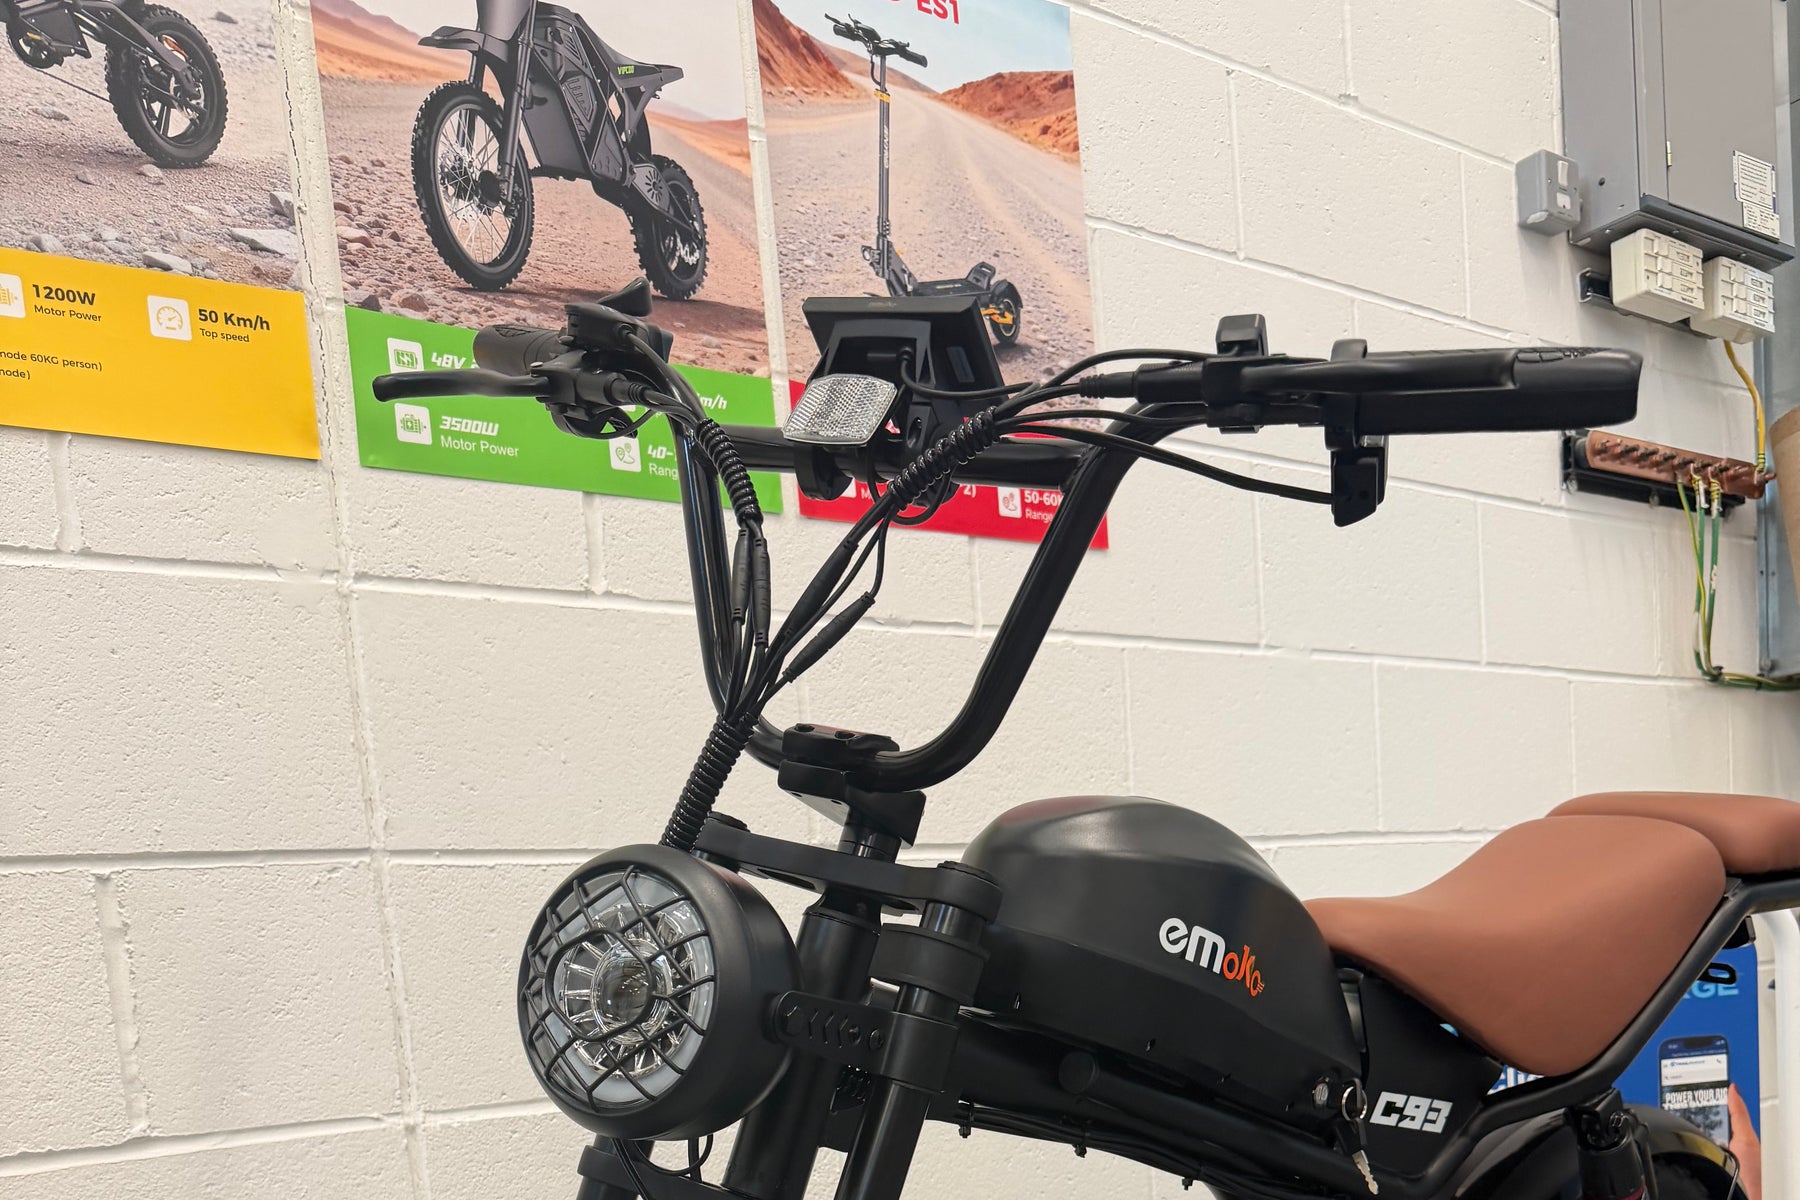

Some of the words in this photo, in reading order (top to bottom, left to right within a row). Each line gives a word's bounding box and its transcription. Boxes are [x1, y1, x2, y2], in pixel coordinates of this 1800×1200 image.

[32, 284, 96, 306] 1200W
[34, 305, 68, 318] Motor
[69, 310, 102, 322] Power
[198, 308, 219, 325] 50
[224, 312, 270, 331] Km/h
[199, 328, 218, 341] Top
[220, 332, 250, 343] speed
[30, 353, 59, 365] 60KG
[62, 358, 102, 372] person)
[431, 352, 466, 369] 48V
[697, 392, 727, 411] m/h
[440, 415, 499, 436] 3500W
[441, 435, 477, 452] Motor
[480, 440, 519, 457] Power
[649, 462, 678, 480] Rang
[1369, 1091, 1453, 1134] C93
